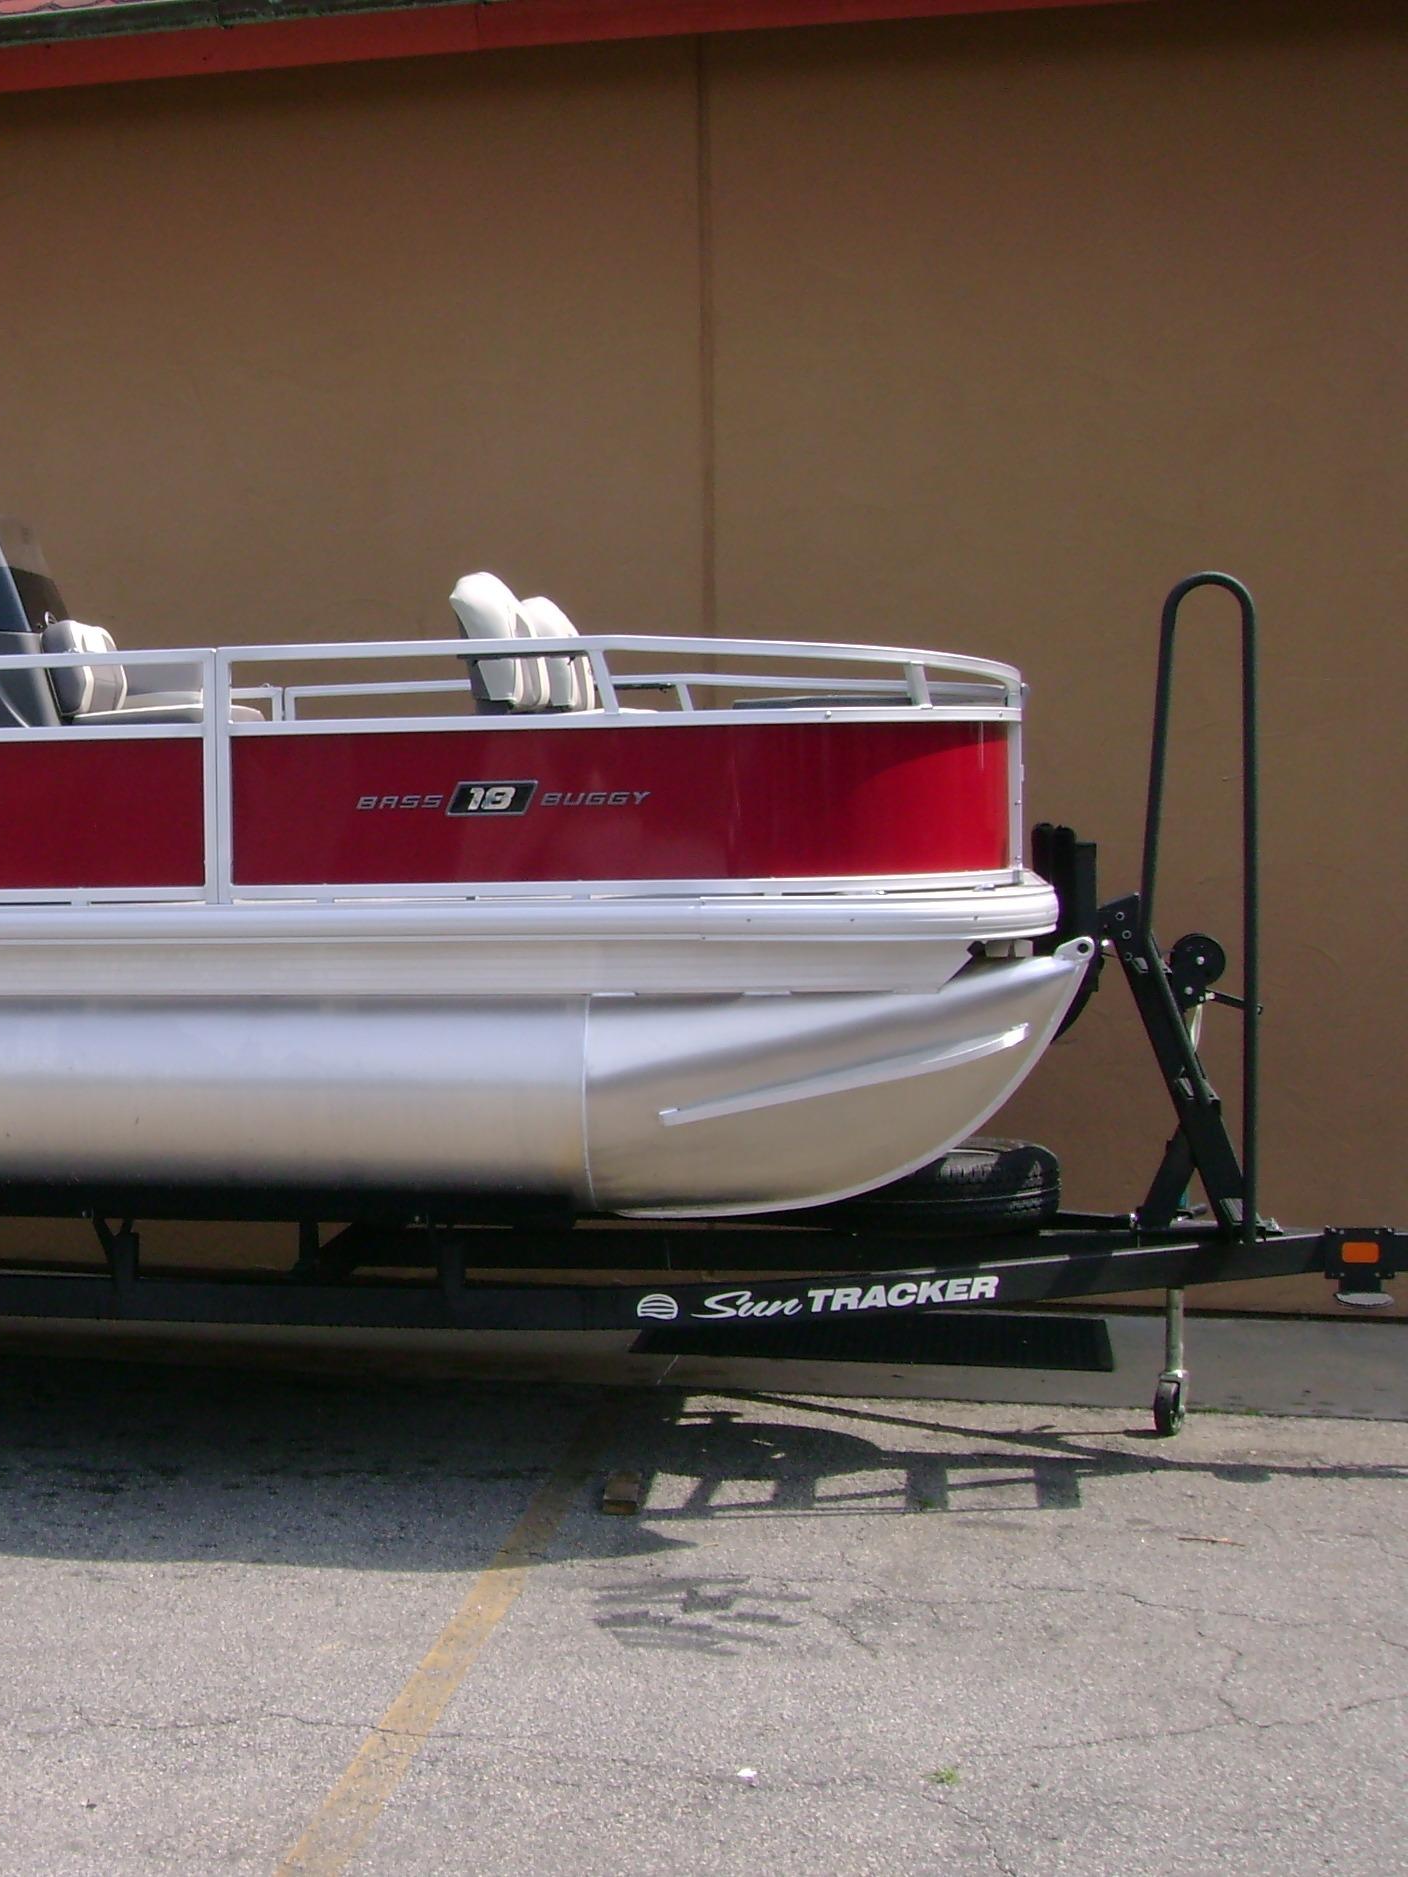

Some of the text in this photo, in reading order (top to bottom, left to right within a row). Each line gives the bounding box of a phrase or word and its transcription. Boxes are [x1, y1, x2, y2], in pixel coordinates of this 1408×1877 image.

[355, 786, 651, 811] BASS 18 BUGGY
[690, 1276, 999, 1319] Sun TRACKER
